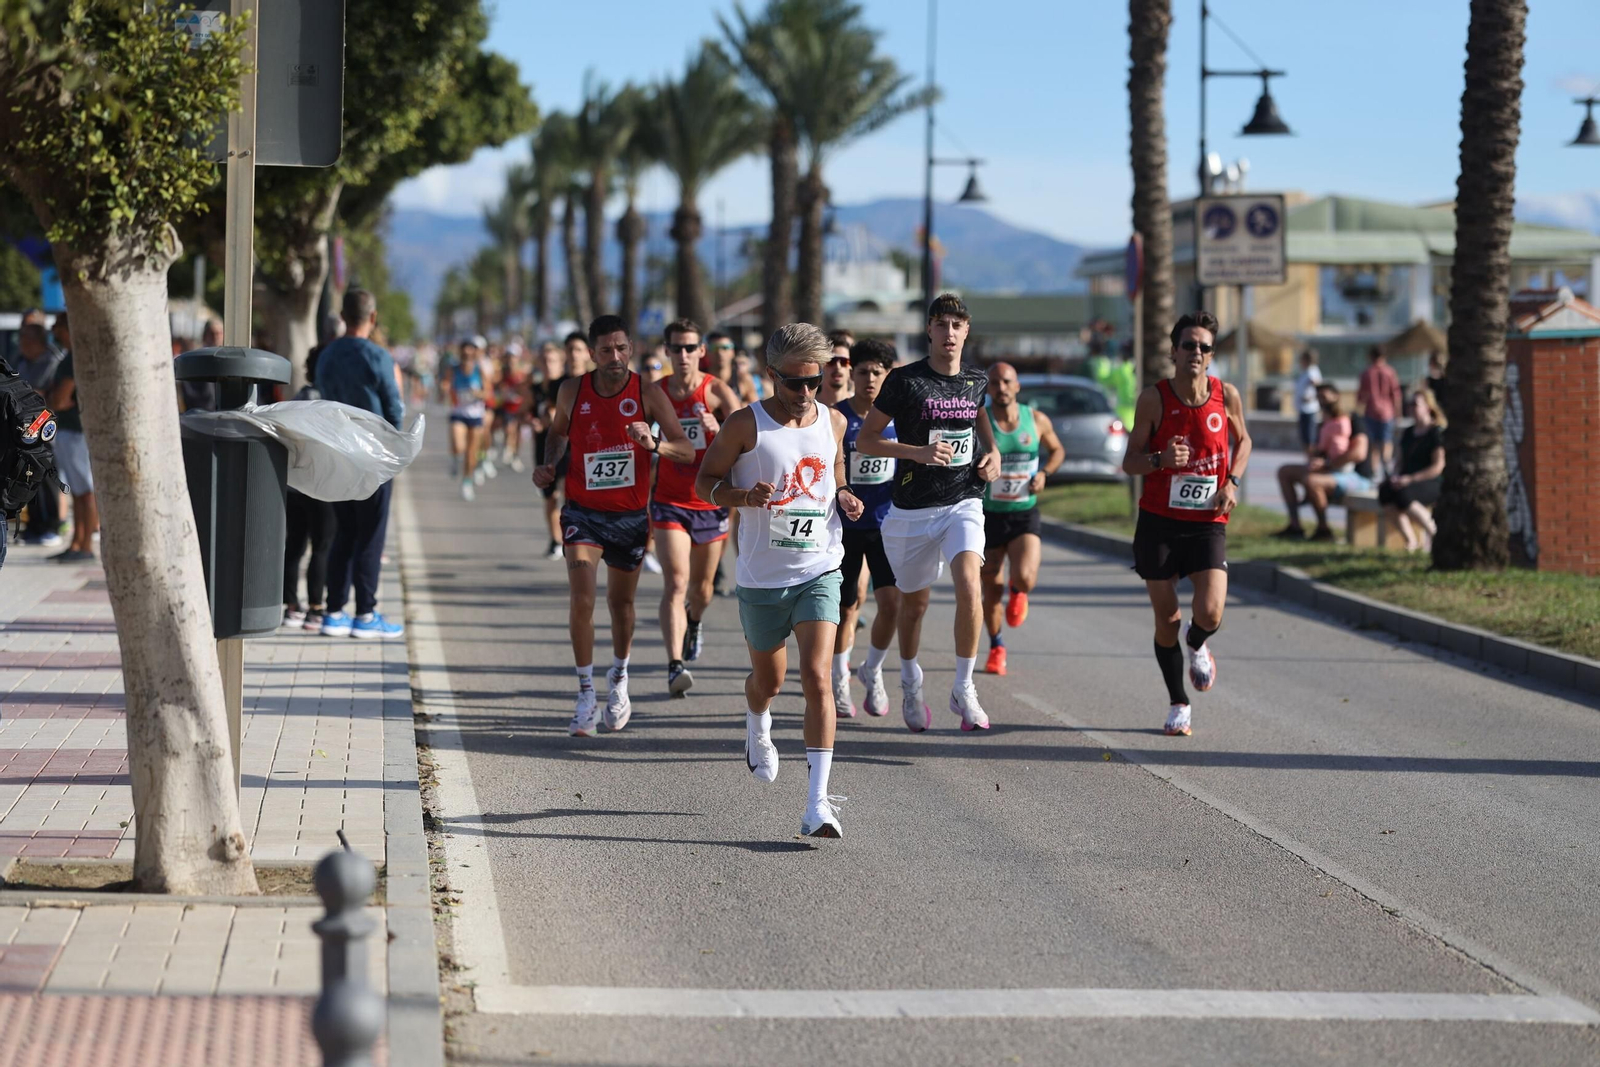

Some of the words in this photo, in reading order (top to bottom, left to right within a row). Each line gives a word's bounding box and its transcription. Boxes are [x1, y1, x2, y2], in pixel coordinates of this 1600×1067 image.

[925, 396, 976, 409] Triatlón
[592, 460, 628, 478] 437
[859, 458, 889, 474] 881
[1002, 480, 1021, 493] 37
[1180, 484, 1211, 500] 661
[790, 518, 814, 537] 14
